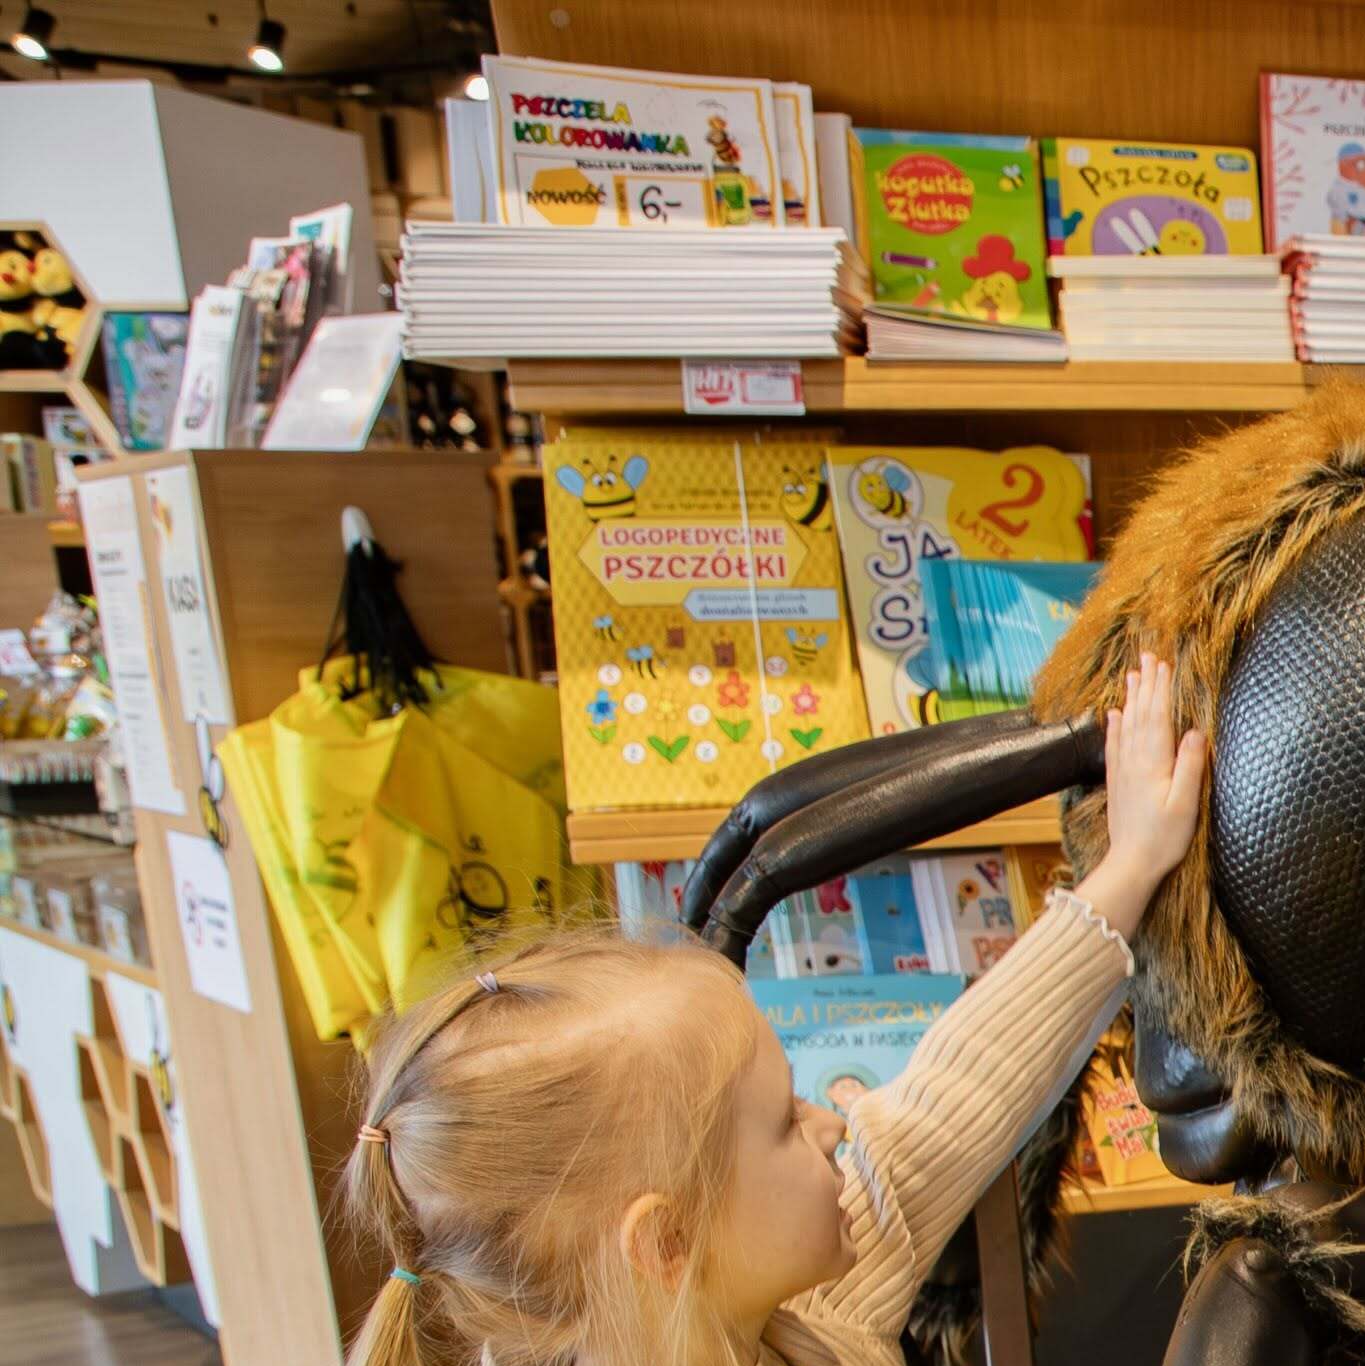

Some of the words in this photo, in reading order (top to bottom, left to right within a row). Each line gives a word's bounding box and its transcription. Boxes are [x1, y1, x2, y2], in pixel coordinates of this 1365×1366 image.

[510, 93, 632, 125] PSZCZELA
[513, 121, 690, 157] KOLOROWANKA
[526, 182, 608, 206] NOWOŚĆ
[1079, 165, 1221, 203] Pszczoła
[979, 464, 1045, 537] 2
[600, 527, 785, 546] LOGOPEDYCZNE
[603, 547, 787, 580] PSZCZÓŁKI
